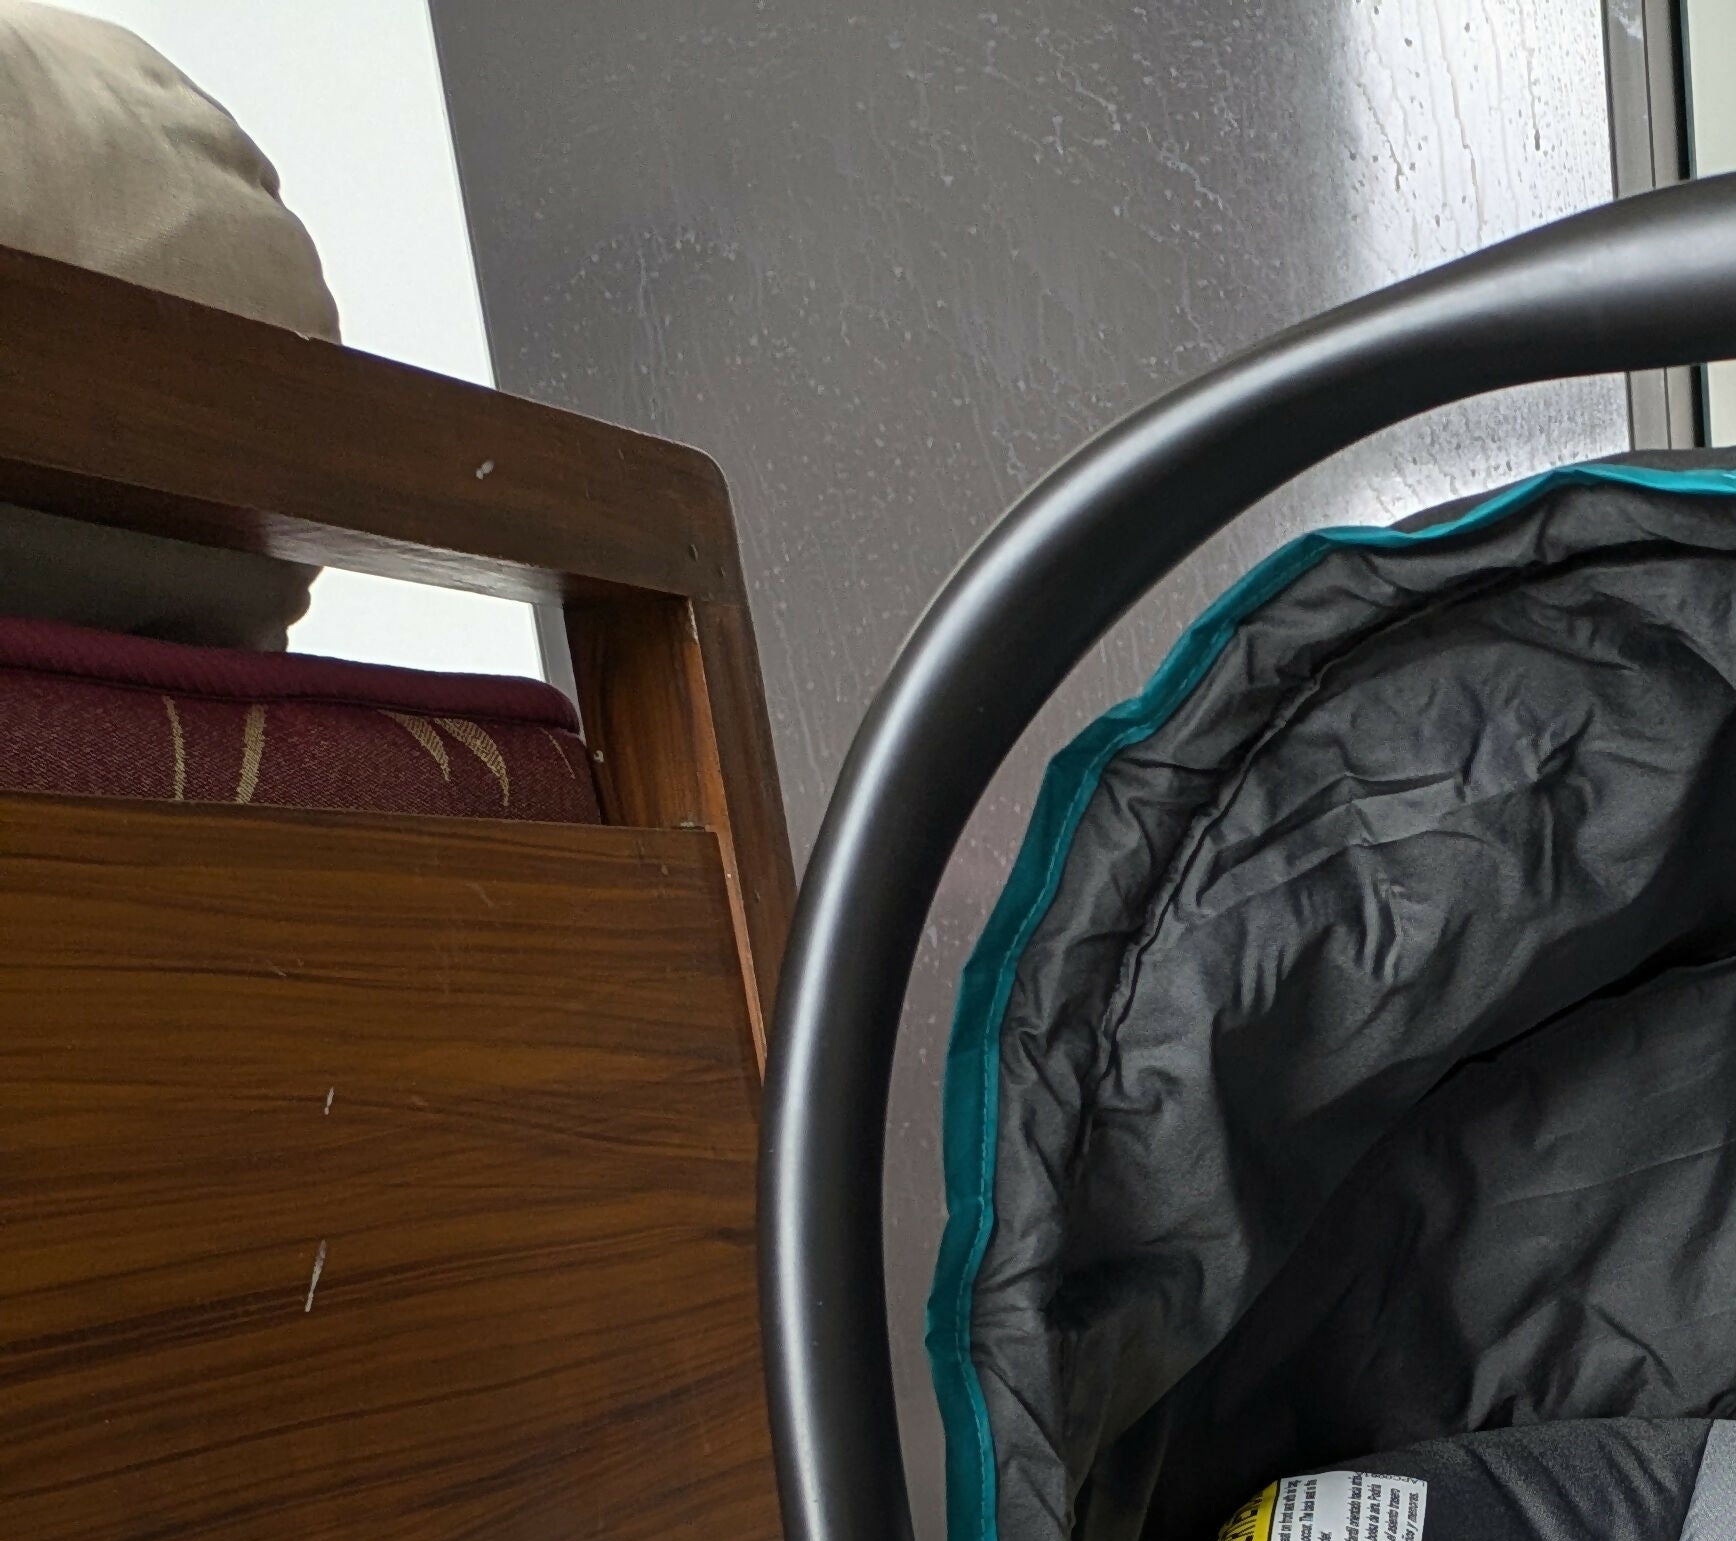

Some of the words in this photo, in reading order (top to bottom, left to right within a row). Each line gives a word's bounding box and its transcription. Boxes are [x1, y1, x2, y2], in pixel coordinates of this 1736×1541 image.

[1299, 1513, 1313, 1522] The
[1366, 1515, 1379, 1523] de
[1385, 1509, 1399, 1534] asiento
[1300, 1523, 1313, 1541] occur.
[1363, 1523, 1379, 1541] bolsa
[1406, 1521, 1418, 1532] y
[1384, 1531, 1396, 1541] el
